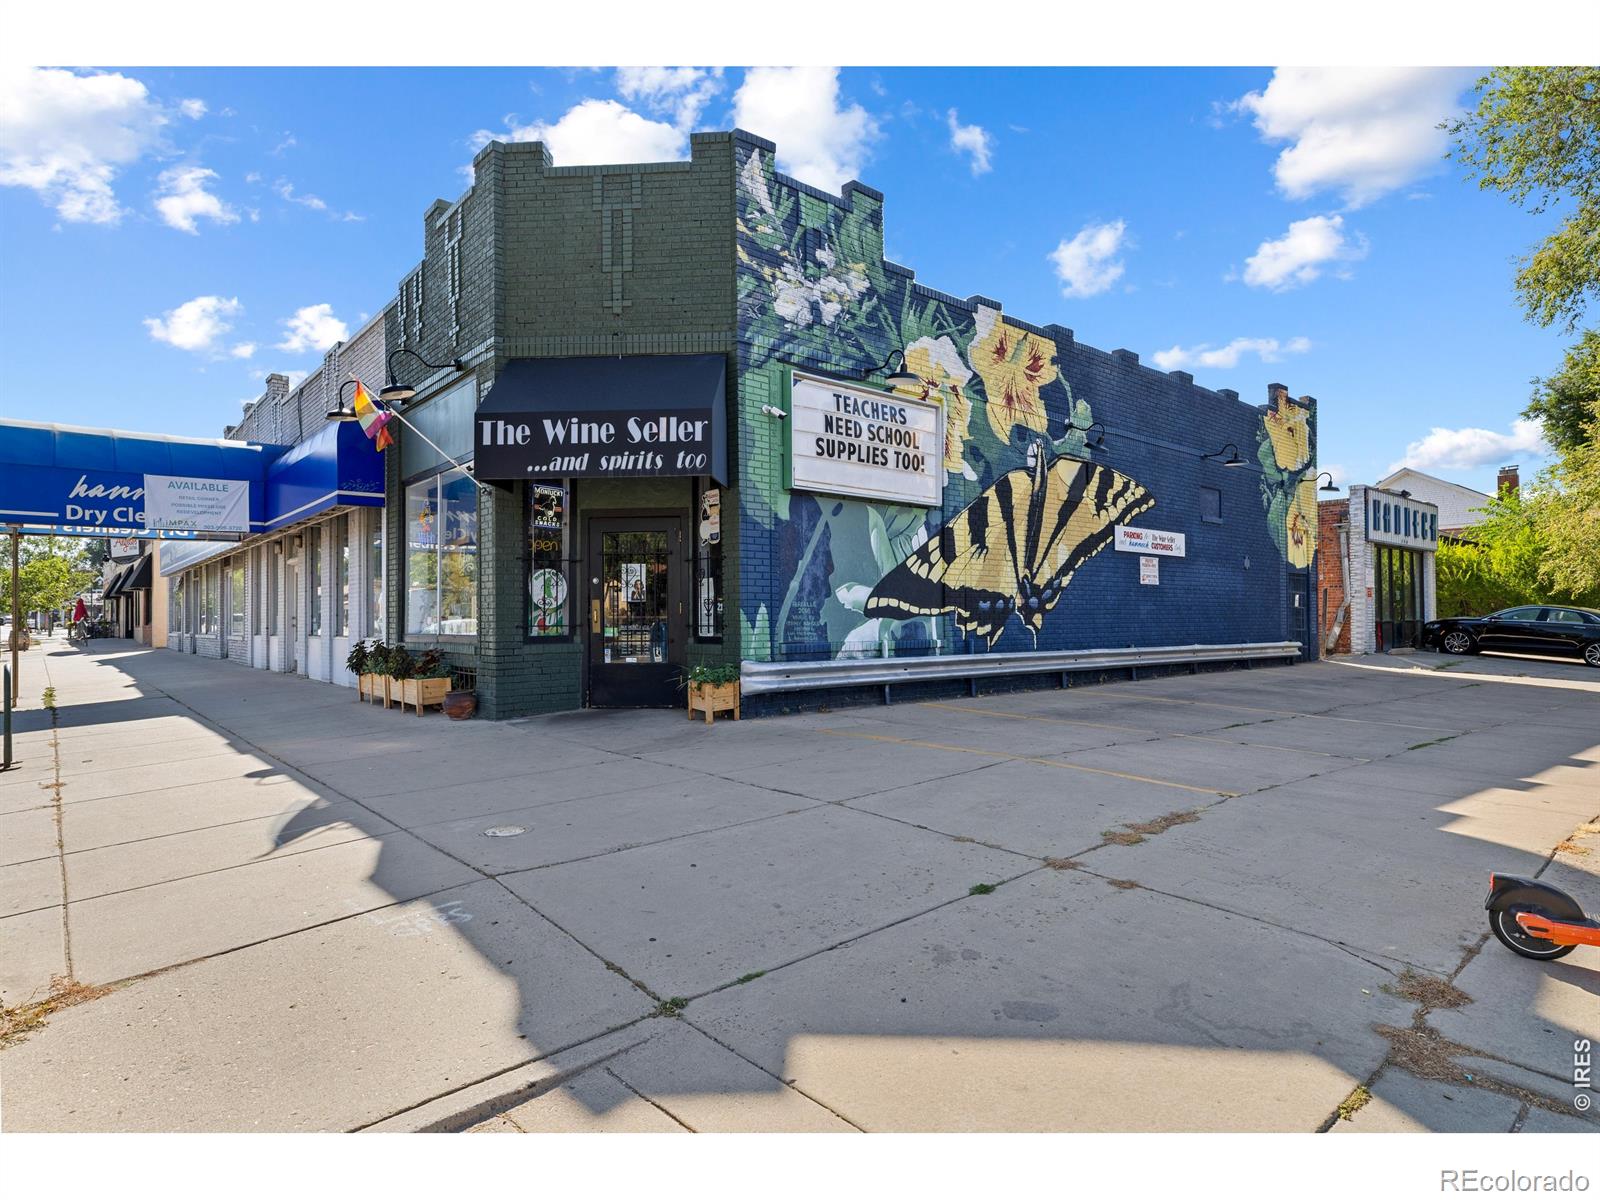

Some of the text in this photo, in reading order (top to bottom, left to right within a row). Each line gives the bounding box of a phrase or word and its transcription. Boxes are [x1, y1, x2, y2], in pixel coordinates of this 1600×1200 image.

[833, 393, 907, 425] TEACHERS
[478, 416, 708, 446] The Wine Seller
[824, 414, 919, 450] NEED SCHOOL
[599, 450, 664, 471] spirits
[676, 450, 707, 469] too
[815, 437, 925, 472] SUPPLIES TOO!
[168, 481, 229, 493] AVAILABLE
[66, 504, 108, 525] Dry
[1123, 530, 1143, 540] PARKING
